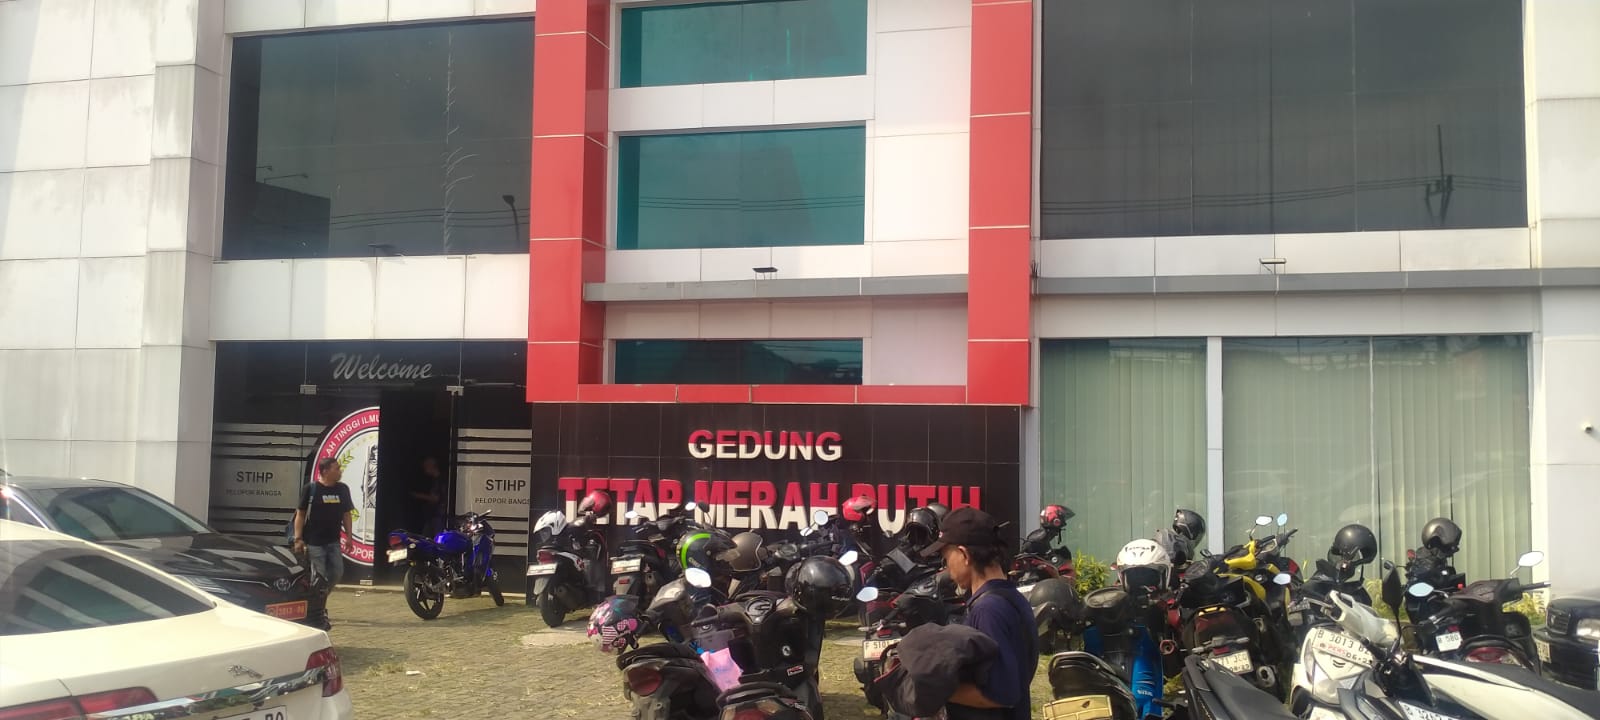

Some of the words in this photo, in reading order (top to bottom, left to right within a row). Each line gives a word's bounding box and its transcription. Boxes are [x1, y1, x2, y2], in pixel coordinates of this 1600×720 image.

[330, 352, 433, 379] Welcome
[334, 420, 361, 442] TINGGI
[688, 429, 842, 461] GEDUNG
[236, 471, 274, 483] STIHP
[485, 479, 526, 491] STIHP
[694, 480, 839, 531] MERAH
